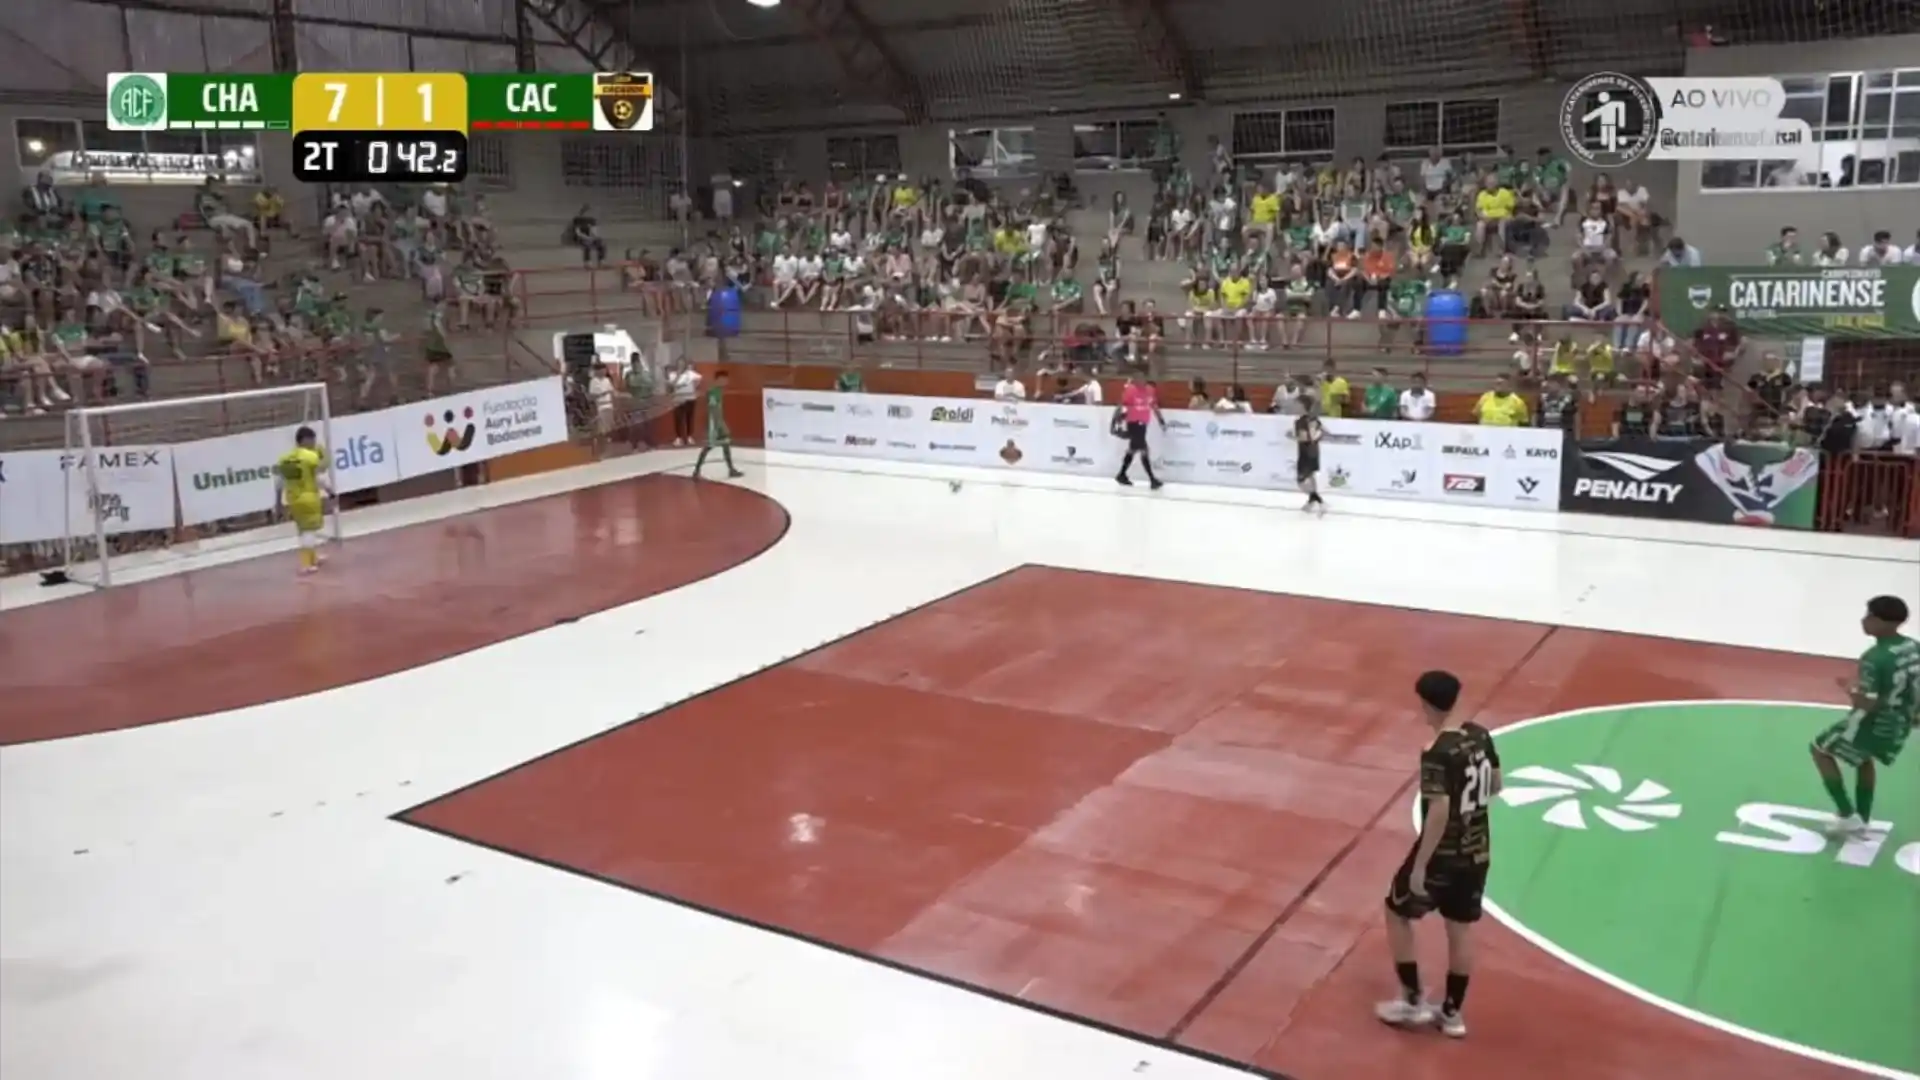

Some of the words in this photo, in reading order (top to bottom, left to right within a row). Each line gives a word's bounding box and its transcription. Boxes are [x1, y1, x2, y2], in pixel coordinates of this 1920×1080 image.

[1729, 279, 1887, 308] CATARINENSE
[485, 414, 513, 430] Aury
[335, 434, 385, 470] alfa
[1573, 477, 1684, 503] PENALTY
[1459, 758, 1492, 816] 20
